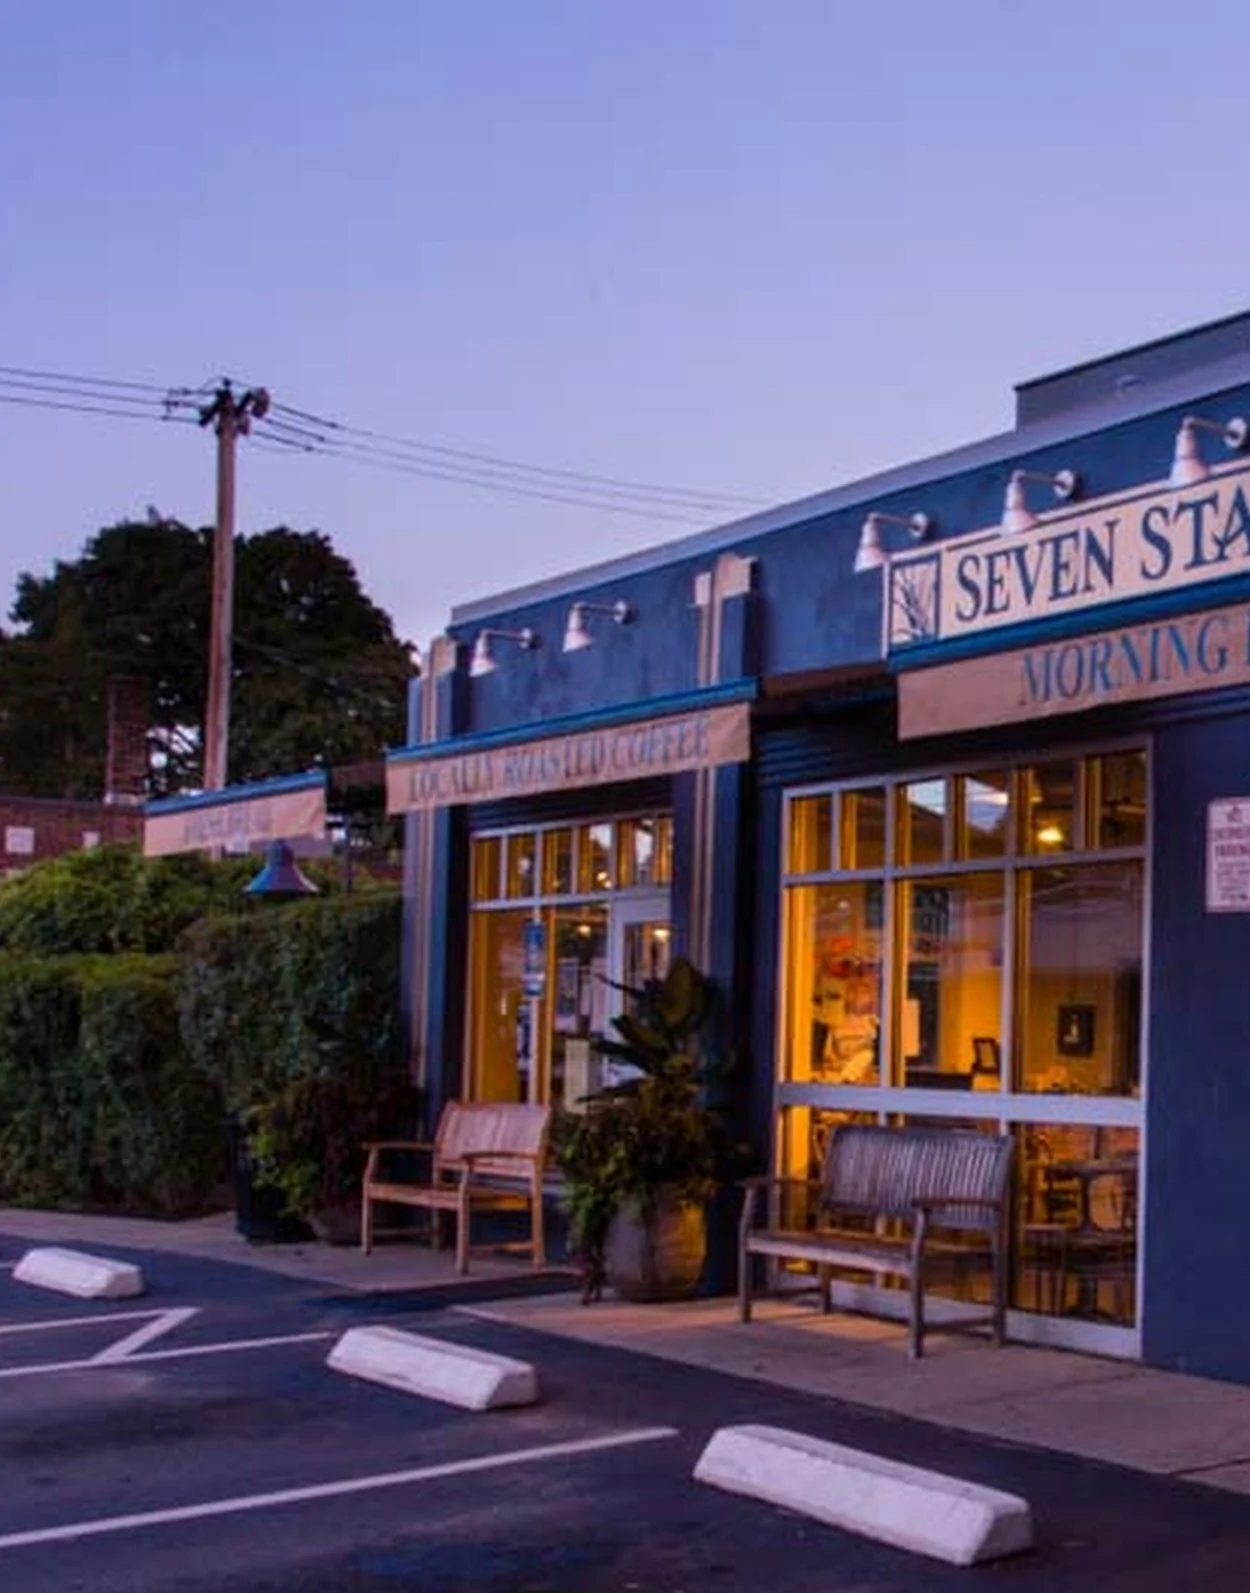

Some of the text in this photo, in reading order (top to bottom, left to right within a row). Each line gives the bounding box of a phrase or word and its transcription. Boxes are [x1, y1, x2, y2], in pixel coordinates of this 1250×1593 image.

[956, 519, 1120, 622] SEVEN
[1020, 616, 1228, 706] MORNING
[612, 716, 710, 773] COFFEE
